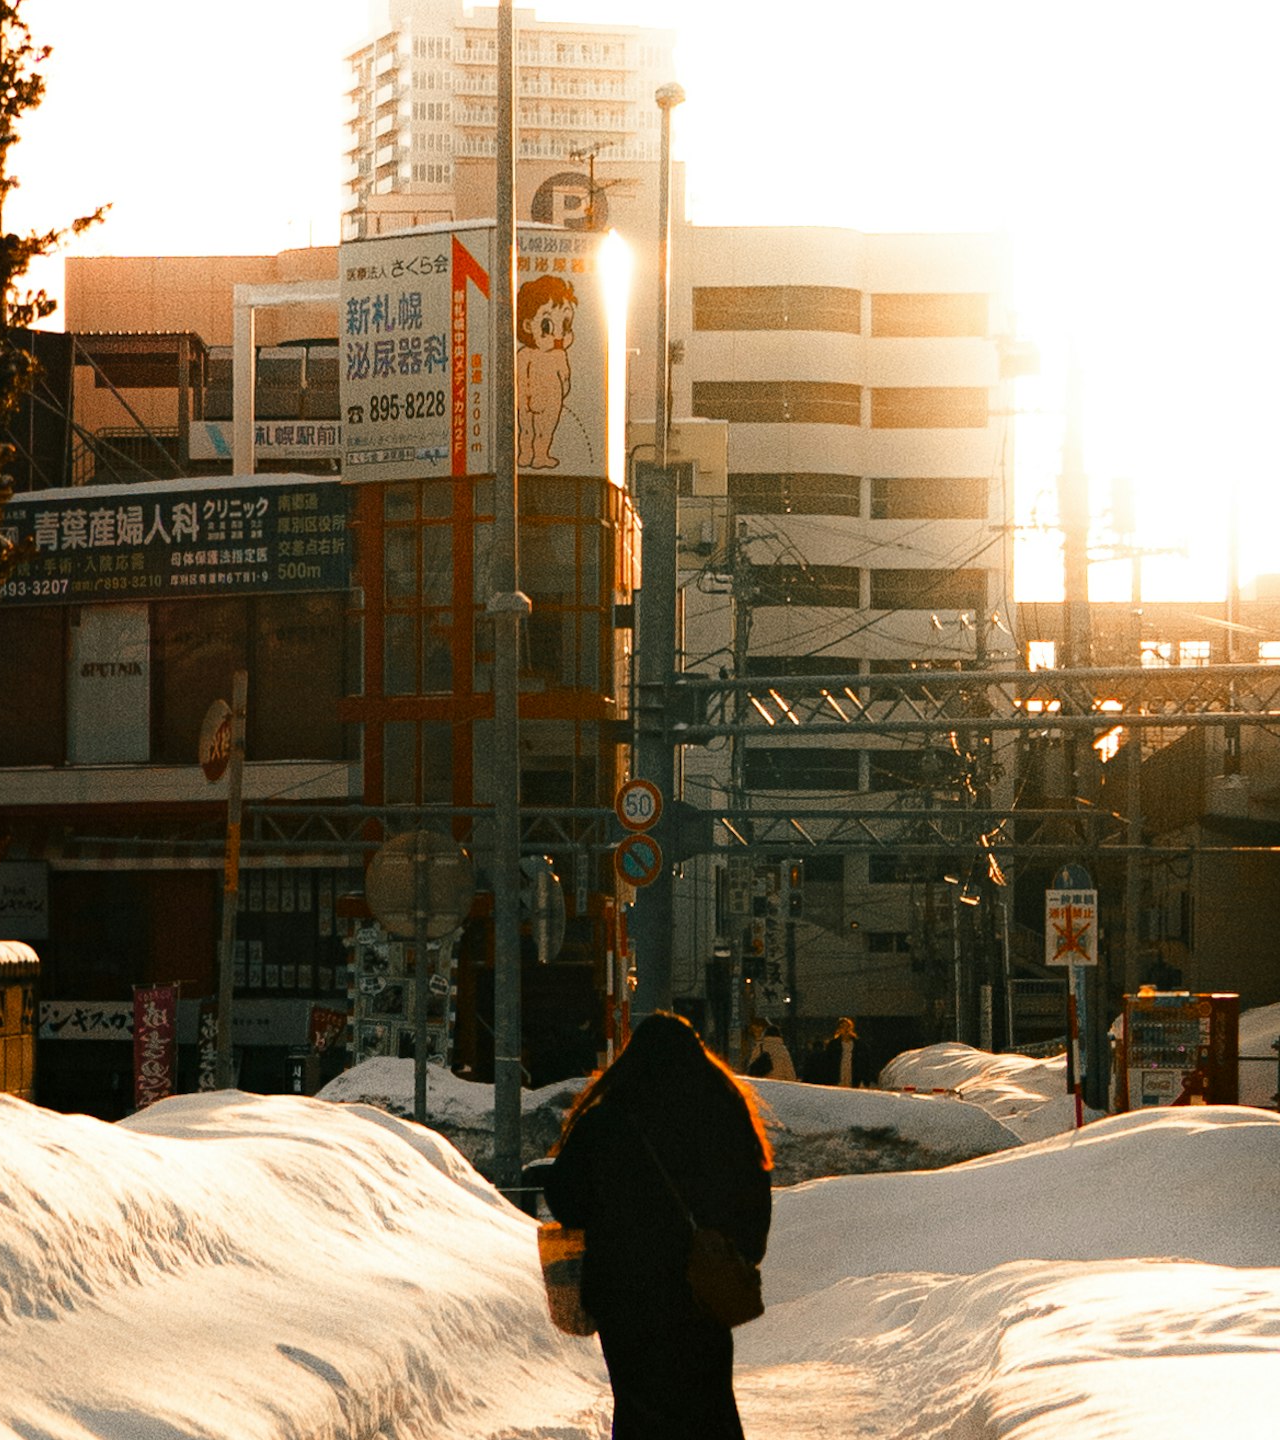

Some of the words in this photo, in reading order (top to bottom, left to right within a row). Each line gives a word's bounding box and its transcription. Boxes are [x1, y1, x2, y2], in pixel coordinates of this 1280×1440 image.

[552, 185, 588, 228] P
[391, 254, 449, 278] さくら会
[347, 292, 423, 335] 新札幌
[347, 333, 449, 381] 泌尿器科
[369, 389, 446, 423] 895-8228
[255, 426, 342, 446] 札幌駅前
[34, 503, 199, 552] 青葉産婦人科
[203, 496, 269, 520] クリニック
[277, 514, 346, 534] 厚別区役所
[277, 537, 346, 557] 交差点右折
[277, 561, 322, 581] 500m
[626, 793, 651, 817] 50
[39, 1003, 134, 1036] ジンギスカ
